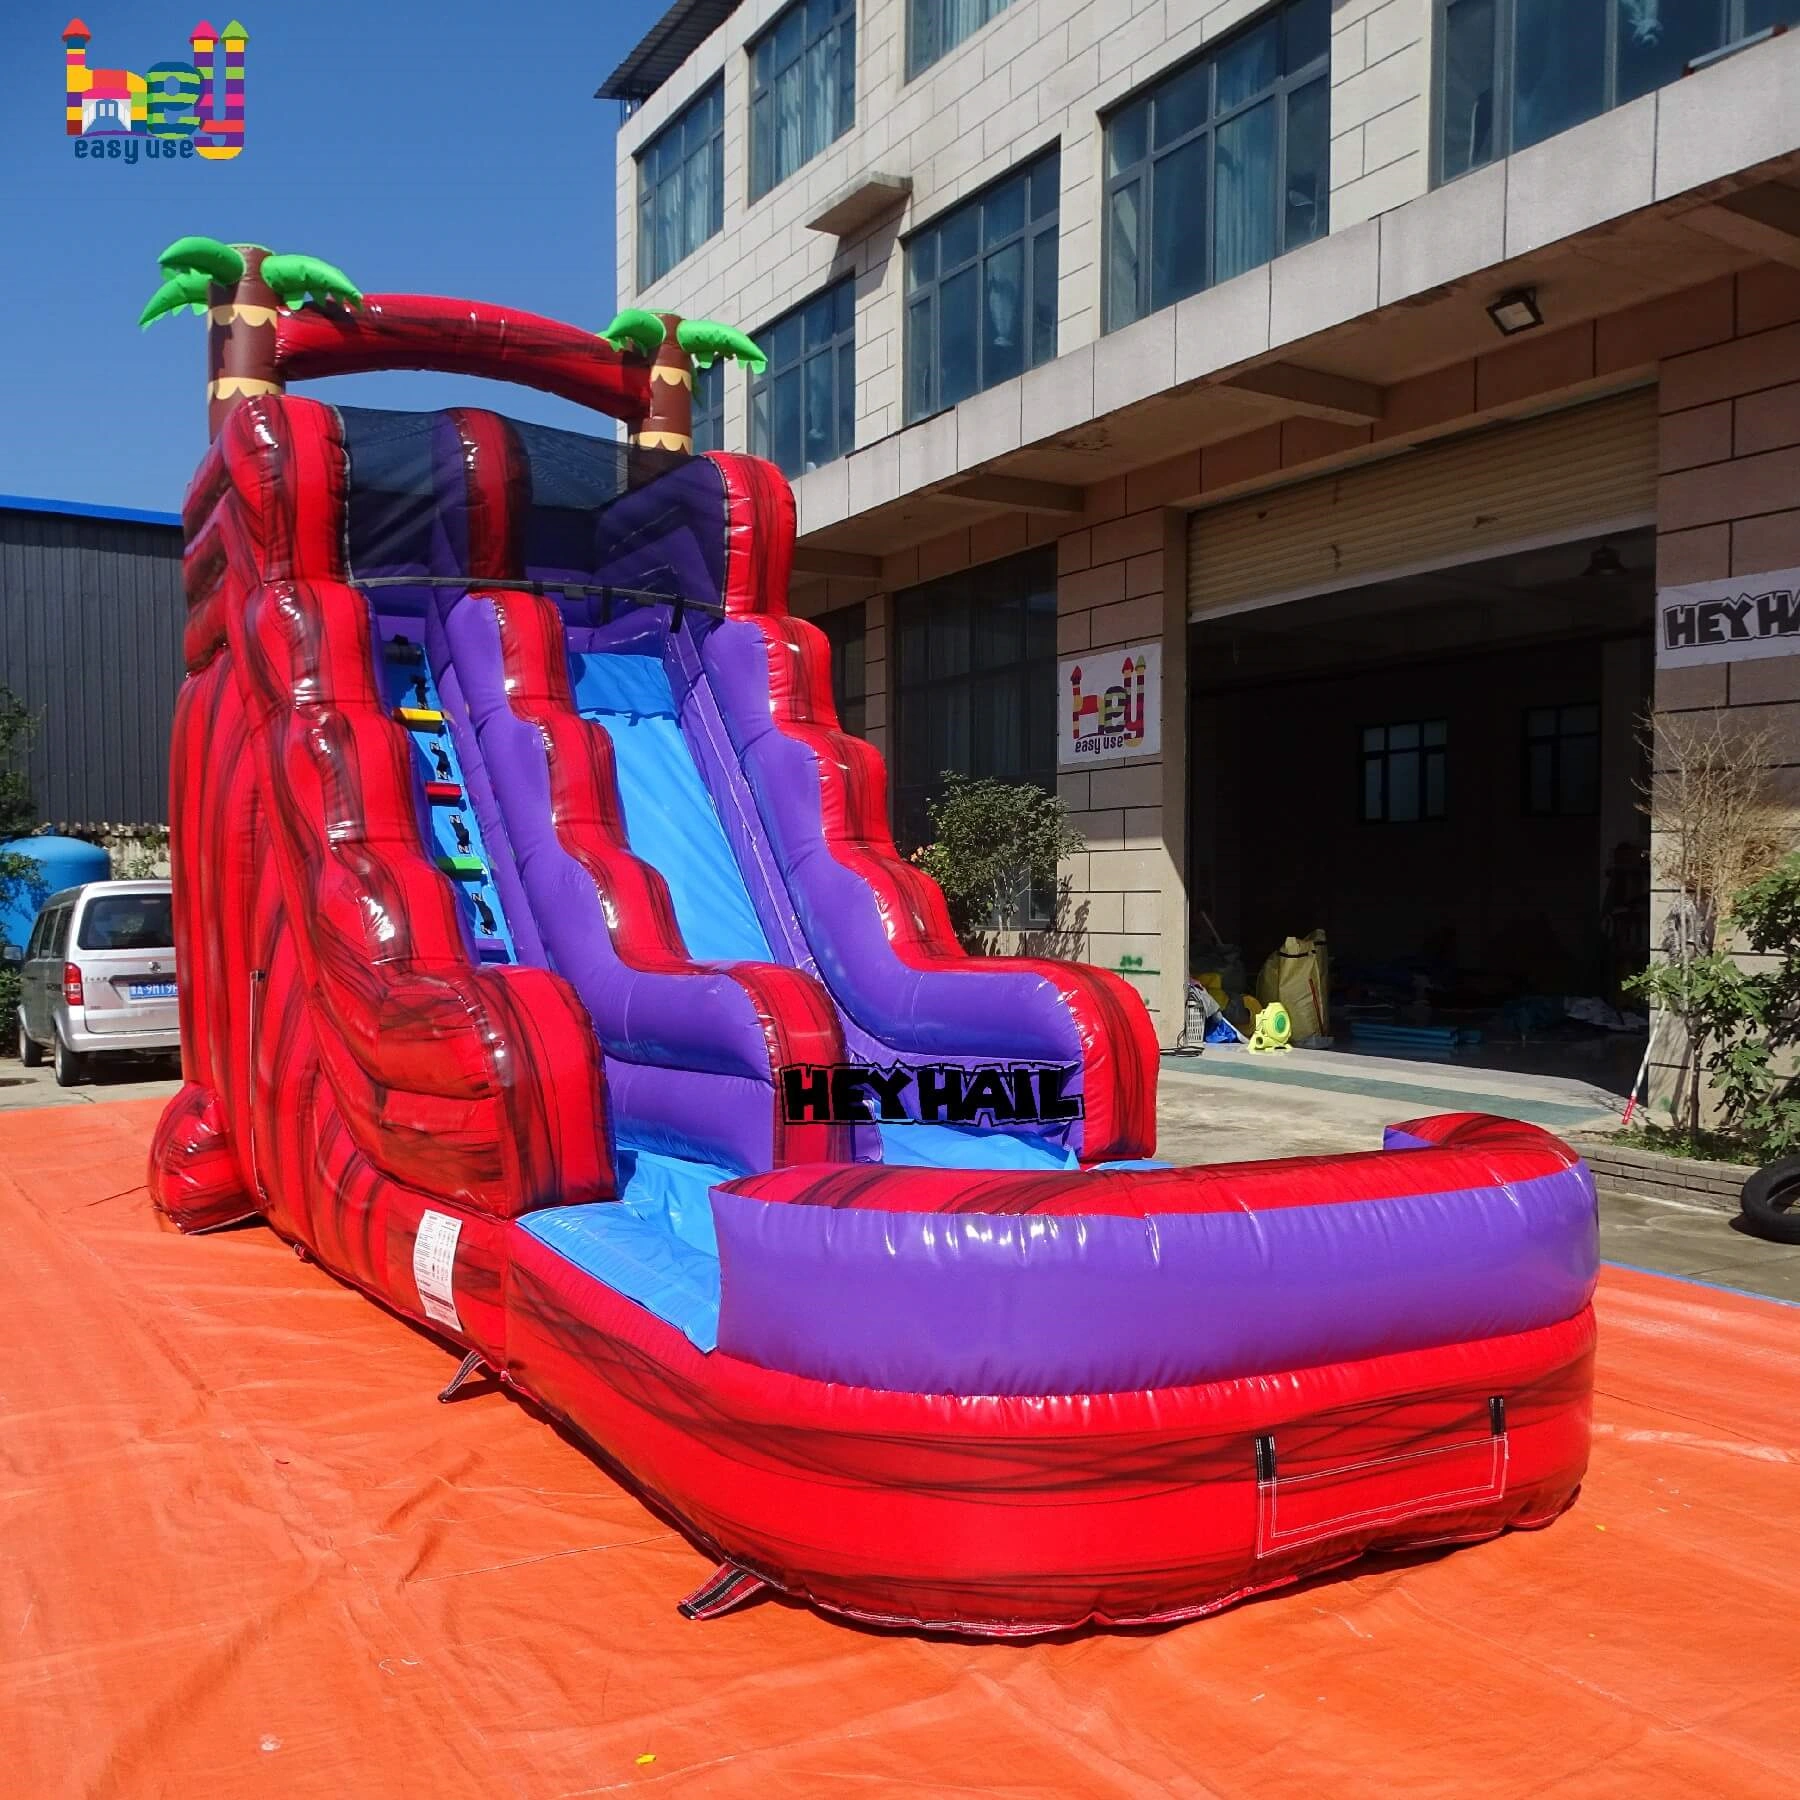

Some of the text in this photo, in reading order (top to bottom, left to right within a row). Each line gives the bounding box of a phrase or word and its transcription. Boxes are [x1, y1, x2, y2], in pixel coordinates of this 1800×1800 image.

[1070, 656, 1146, 748] hey
[1075, 736, 1124, 754] easy use
